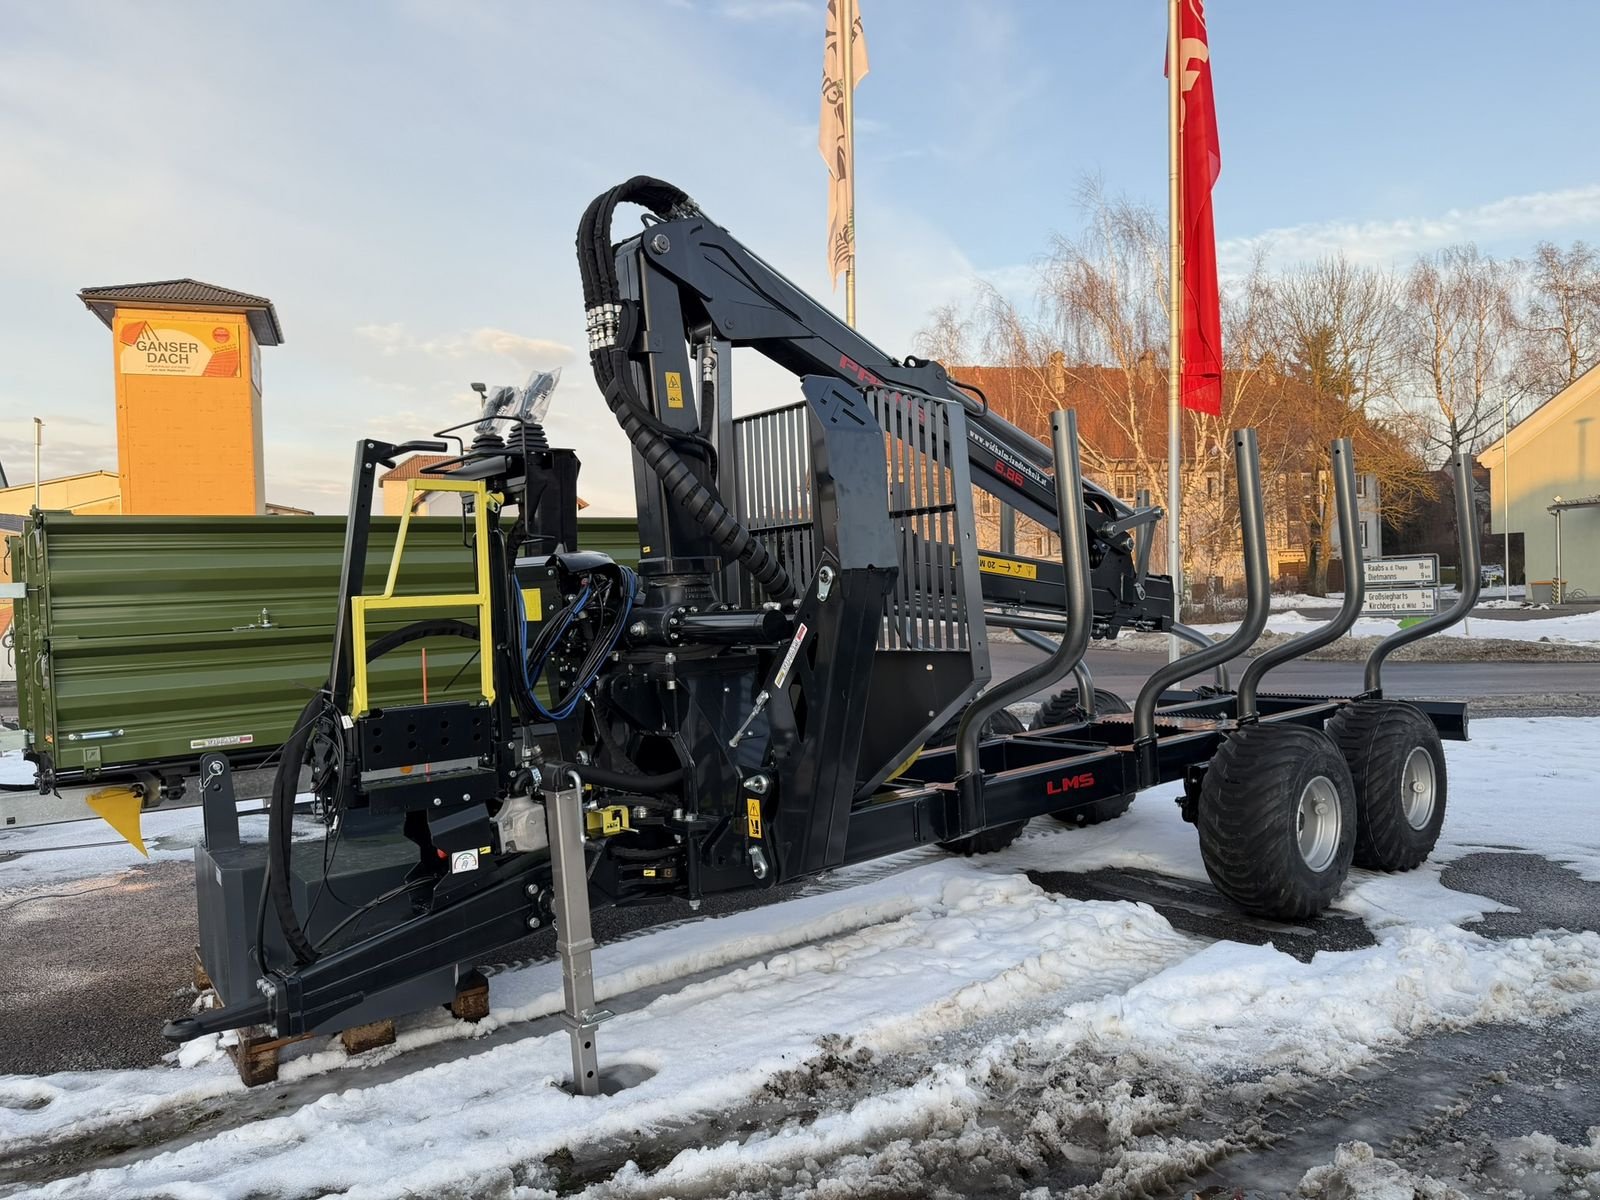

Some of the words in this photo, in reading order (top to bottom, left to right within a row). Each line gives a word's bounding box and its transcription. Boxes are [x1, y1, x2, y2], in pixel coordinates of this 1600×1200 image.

[136, 341, 199, 353] GANSER
[147, 353, 189, 364] DACH
[969, 430, 1047, 486] www.widhalm-landtechnik.at
[1369, 592, 1408, 601] Großsiegharts
[1047, 772, 1094, 795] LMS
